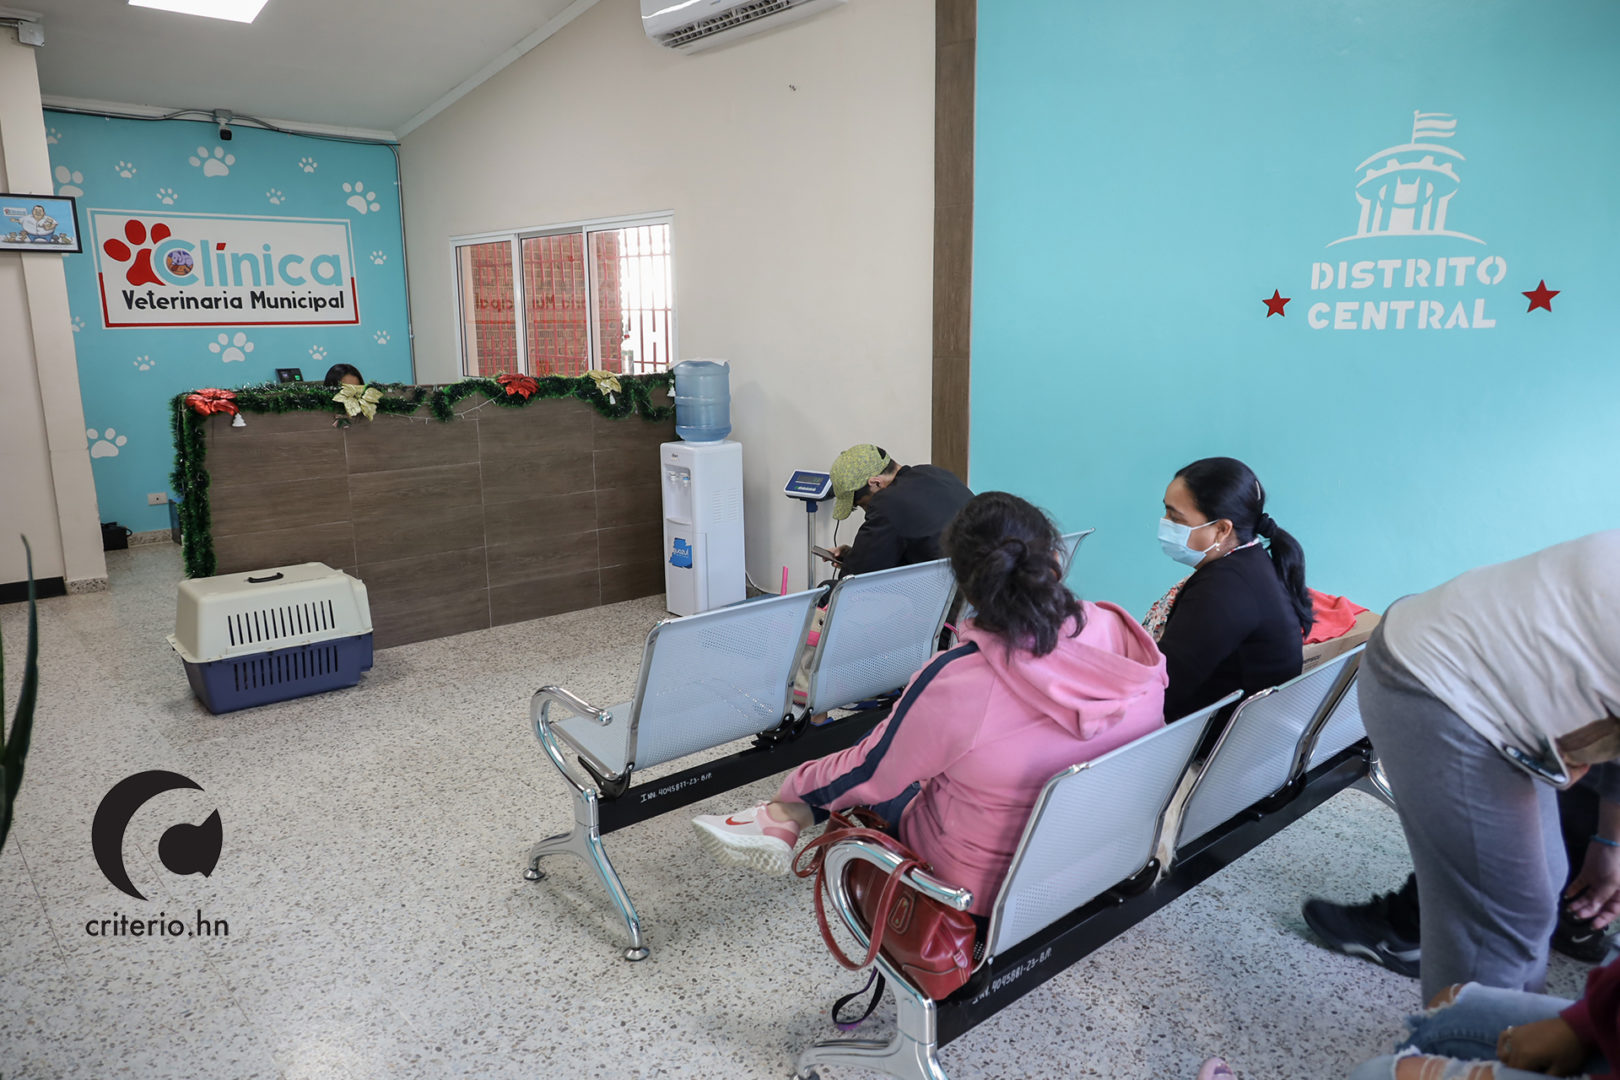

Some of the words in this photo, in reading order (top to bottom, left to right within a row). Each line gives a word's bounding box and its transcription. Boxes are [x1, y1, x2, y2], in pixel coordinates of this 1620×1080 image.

[154, 239, 344, 288] Clínica
[1310, 255, 1507, 290] DISTRITO
[122, 290, 243, 310] Veterinaria
[250, 290, 345, 312] Municipal
[1308, 298, 1497, 330] CENTRAL
